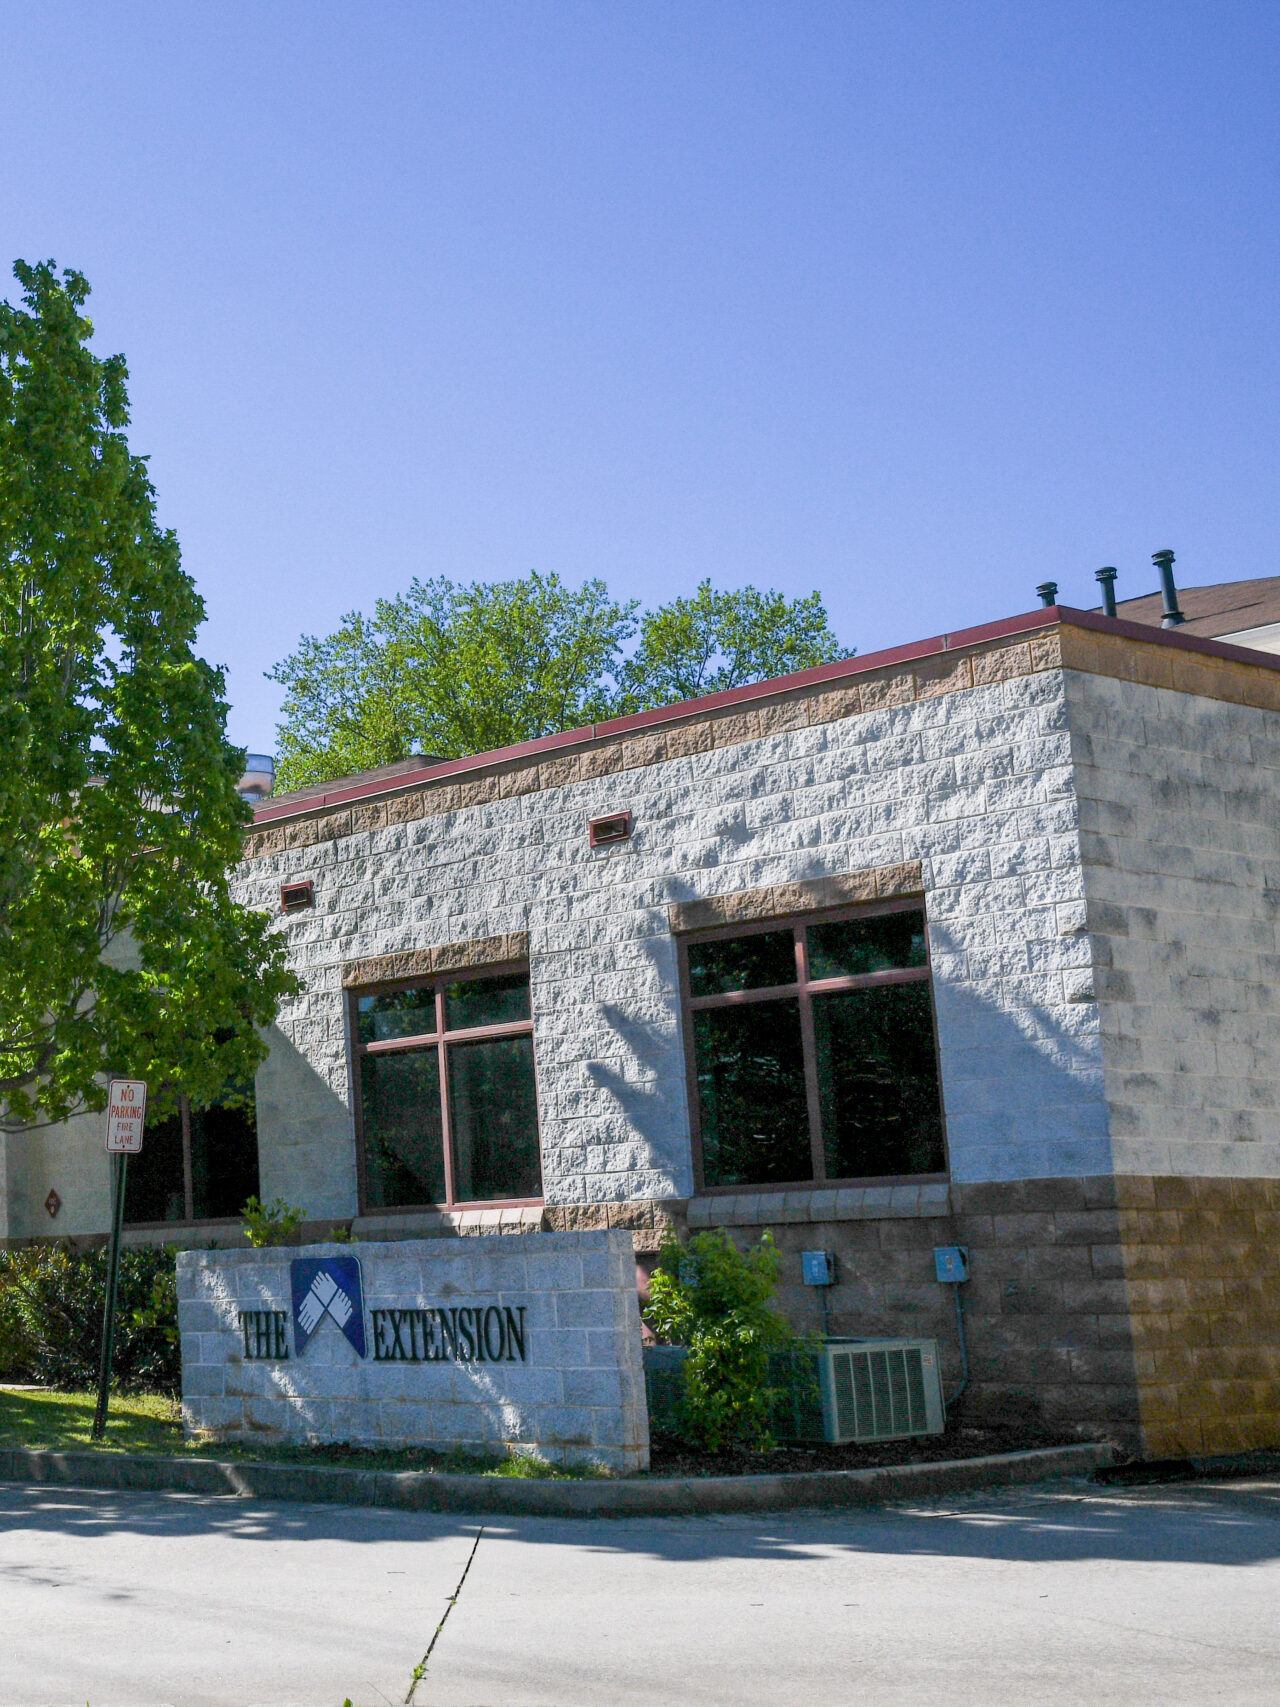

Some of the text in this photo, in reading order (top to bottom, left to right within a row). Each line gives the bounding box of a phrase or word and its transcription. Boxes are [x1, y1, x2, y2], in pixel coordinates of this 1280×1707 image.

[121, 1089, 135, 1102] NO
[111, 1106, 142, 1119] PARKING
[116, 1122, 134, 1132] FIRE
[114, 1135, 134, 1145] LANE
[238, 1306, 527, 1362] THE EXTENSION
